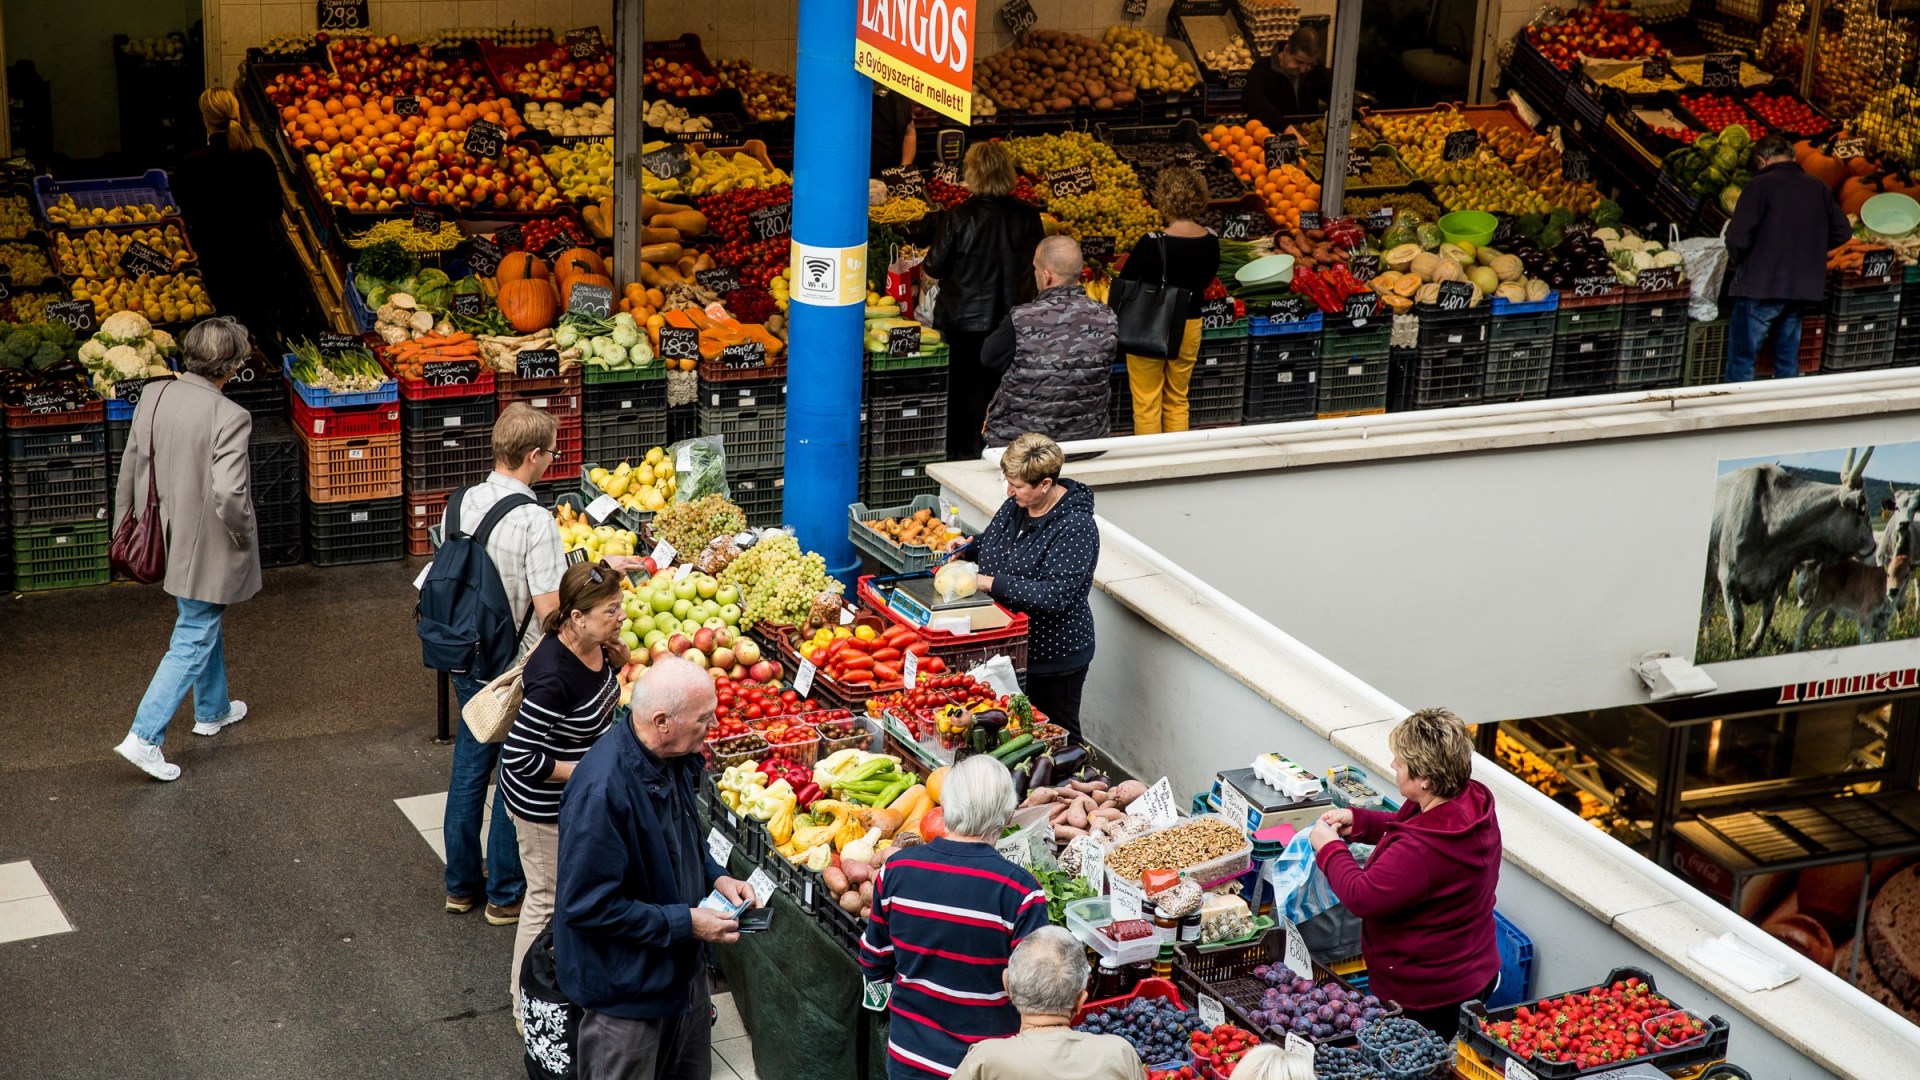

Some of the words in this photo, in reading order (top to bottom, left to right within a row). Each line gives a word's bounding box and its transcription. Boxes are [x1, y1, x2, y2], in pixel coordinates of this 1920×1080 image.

[322, 6, 360, 28] 298
[858, 53, 865, 65] a
[865, 52, 926, 96] Gyógyszertár
[926, 85, 965, 114] mellett!
[1054, 180, 1077, 197] 680
[469, 252, 498, 276] 580
[661, 337, 691, 356] 480
